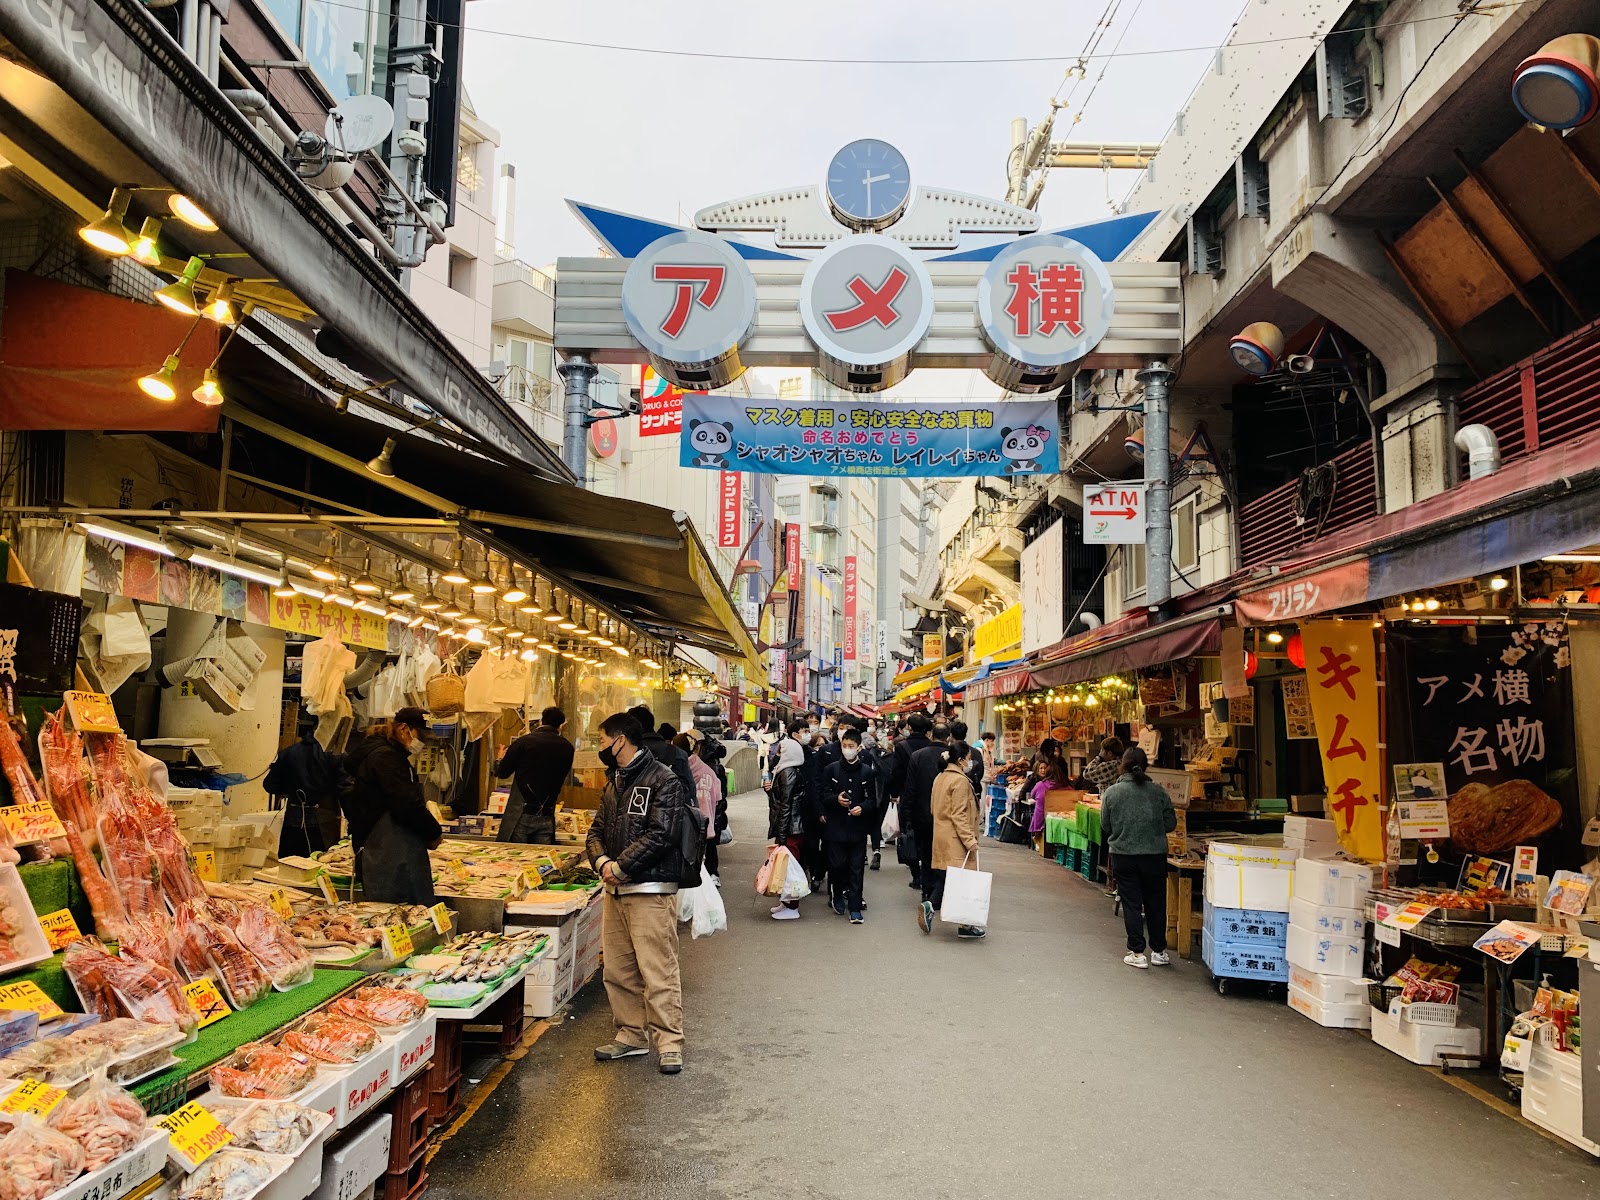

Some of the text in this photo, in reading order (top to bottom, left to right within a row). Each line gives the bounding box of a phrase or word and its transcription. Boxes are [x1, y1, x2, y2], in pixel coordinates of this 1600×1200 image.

[1282, 232, 1302, 268] 240
[653, 262, 1086, 339] アメ横
[745, 407, 994, 429] マスク着用・安心安全なお買物
[736, 442, 1001, 466] シャオシャオちゃん レイレイちゃん
[803, 430, 919, 446] 命名おめでとう
[1090, 490, 1139, 506] ATM
[846, 562, 855, 603] カラオケ
[1267, 581, 1320, 618] アリラン
[297, 599, 363, 643] 京和水産
[1417, 669, 1532, 707] アメ横
[1317, 646, 1370, 834] キムチ
[1448, 716, 1546, 776] 名物
